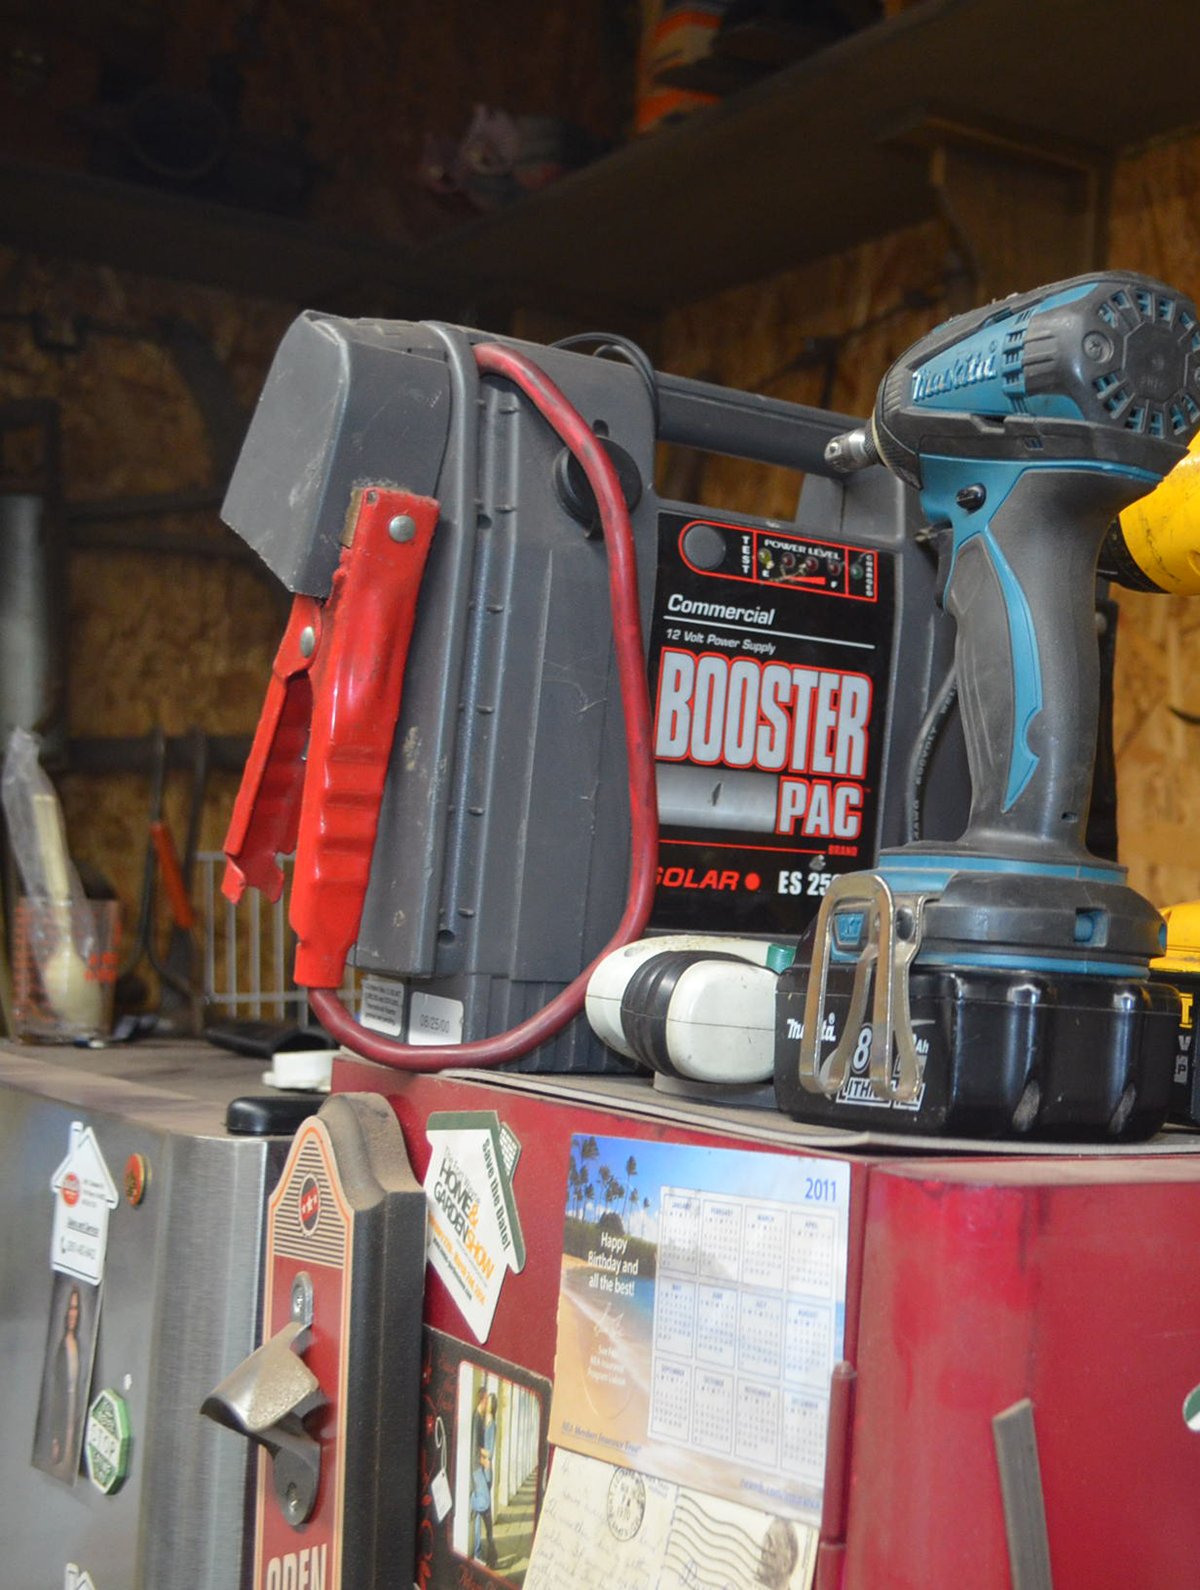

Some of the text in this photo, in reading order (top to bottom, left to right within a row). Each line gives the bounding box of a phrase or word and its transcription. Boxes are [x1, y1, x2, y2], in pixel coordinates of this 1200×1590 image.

[912, 350, 998, 401] Makita
[742, 535, 750, 574] TEST
[764, 538, 840, 560] POWER LEVEL
[667, 593, 776, 626] Commercial
[666, 628, 776, 656] 12 Volt Power Supply
[654, 646, 874, 780] BOOSTER
[776, 774, 864, 840] PAC
[778, 870, 841, 897] ES 25
[805, 1177, 837, 1202] 2011
[600, 1231, 628, 1255] Happy
[587, 1250, 639, 1276] Birthday and
[588, 1272, 635, 1297] all the best!
[266, 1543, 328, 1590] OPEN
